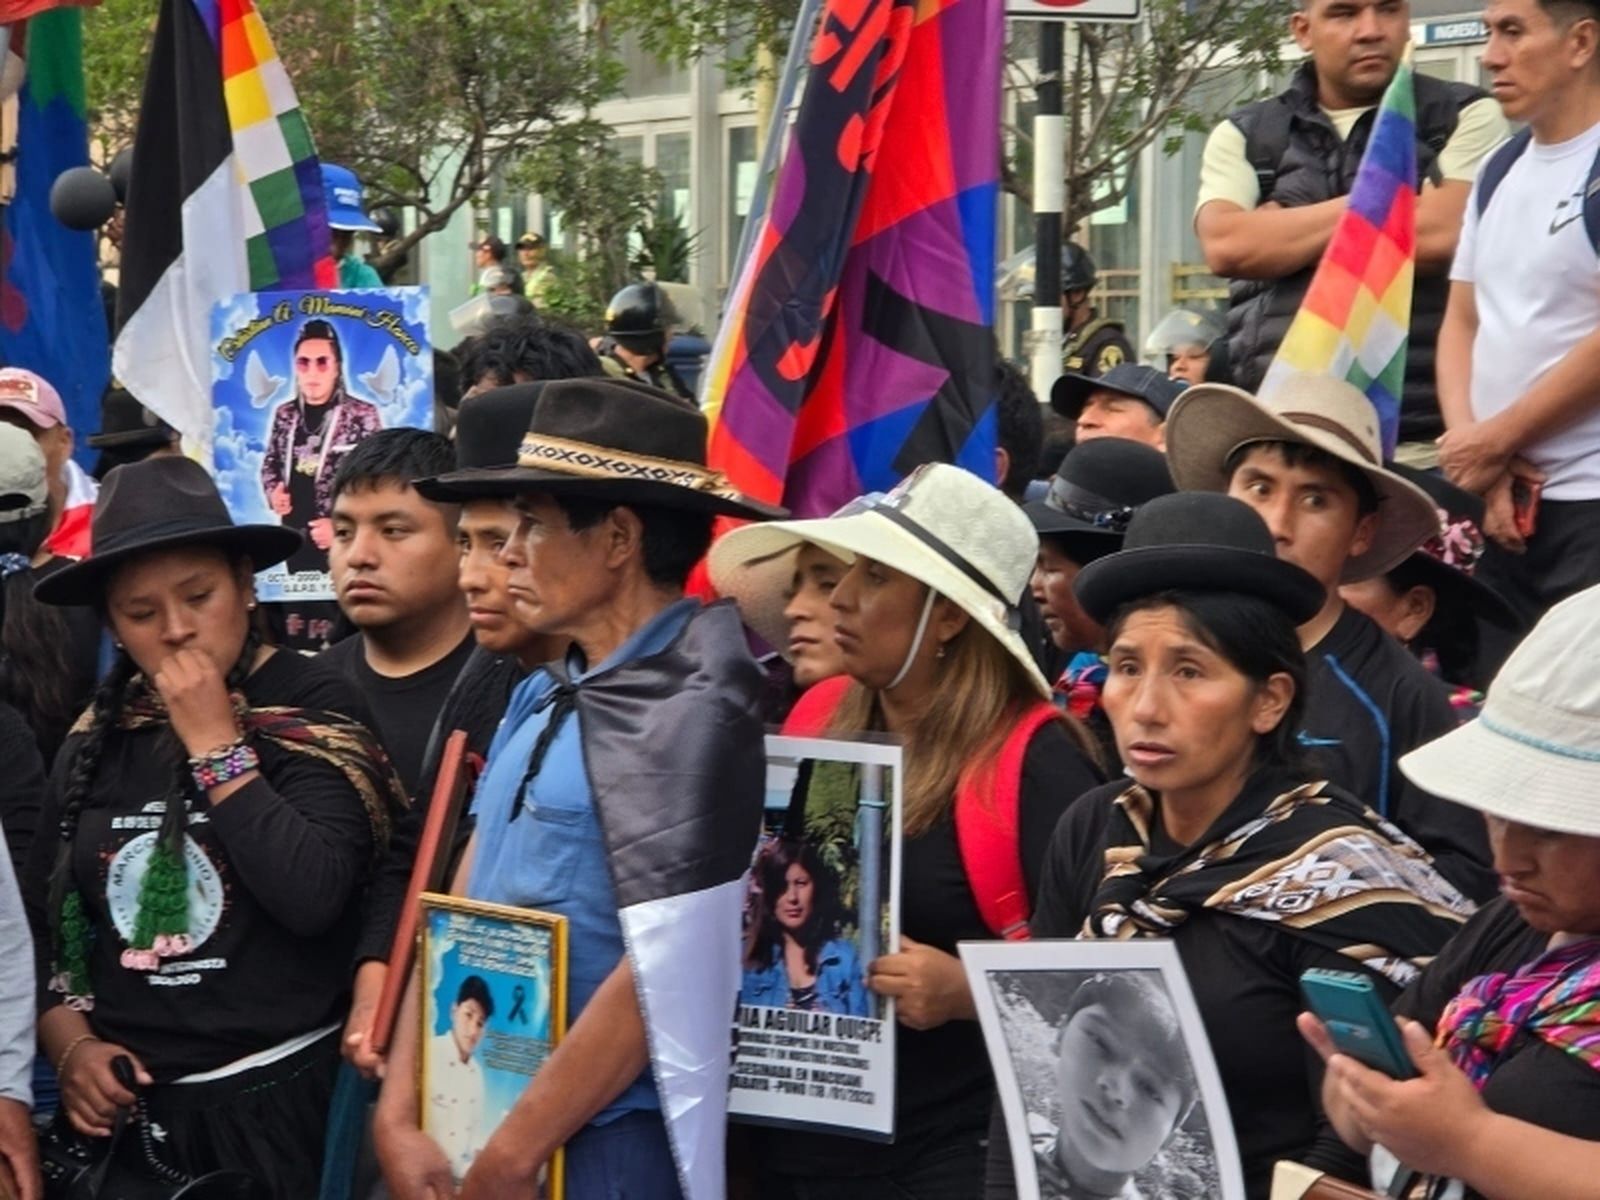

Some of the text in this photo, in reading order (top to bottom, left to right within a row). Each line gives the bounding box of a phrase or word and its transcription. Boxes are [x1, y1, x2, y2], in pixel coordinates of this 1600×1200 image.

[1434, 21, 1479, 40] INGRESO
[764, 1009, 832, 1036] AGUILAR
[835, 1016, 882, 1043] QUISPE
[735, 1061, 792, 1079] SESINADA
